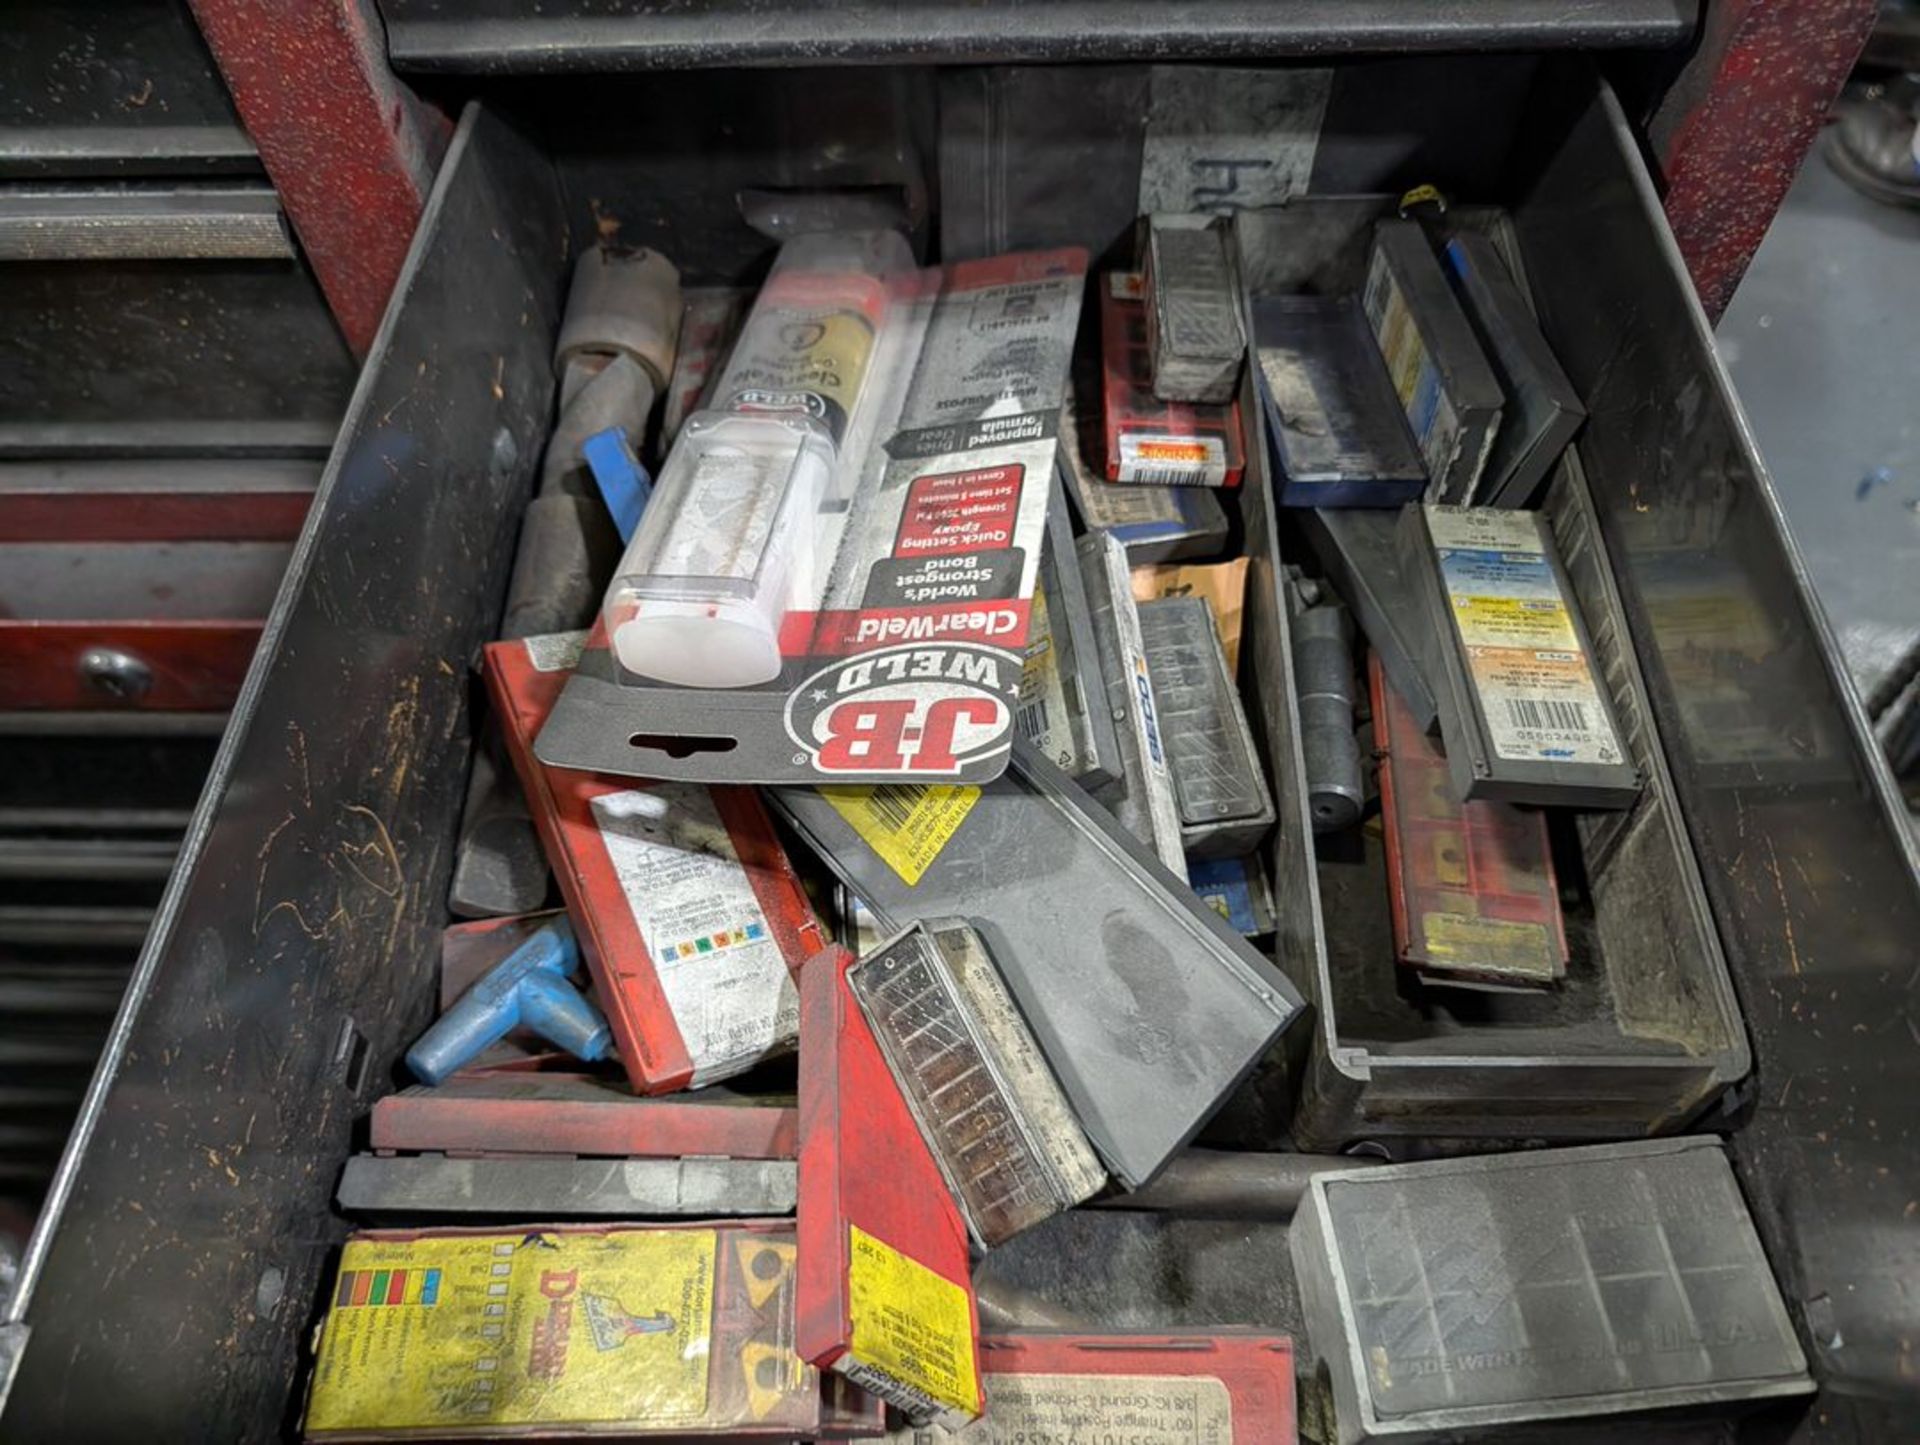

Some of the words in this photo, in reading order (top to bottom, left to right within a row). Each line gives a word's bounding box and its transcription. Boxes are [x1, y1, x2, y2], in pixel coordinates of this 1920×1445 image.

[967, 424, 1043, 447] Improved
[917, 490, 960, 504] minutes
[969, 488, 993, 500] time
[993, 486, 1013, 498] Set
[960, 501, 1008, 517] Strength
[931, 521, 982, 538] Epoxy
[958, 528, 1008, 547] Quick
[901, 531, 958, 550] Setting
[924, 555, 979, 573] Bond
[895, 567, 993, 588] Strongest
[903, 582, 979, 601] World's
[856, 610, 1019, 642] ClearWeld
[836, 649, 1001, 693] WELD
[914, 846, 936, 870] MADE
[942, 799, 973, 832] ISRAEL
[1100, 1395, 1149, 1409] Ground
[1174, 1397, 1196, 1410] 3/8
[1114, 1413, 1167, 1432] Triangle
